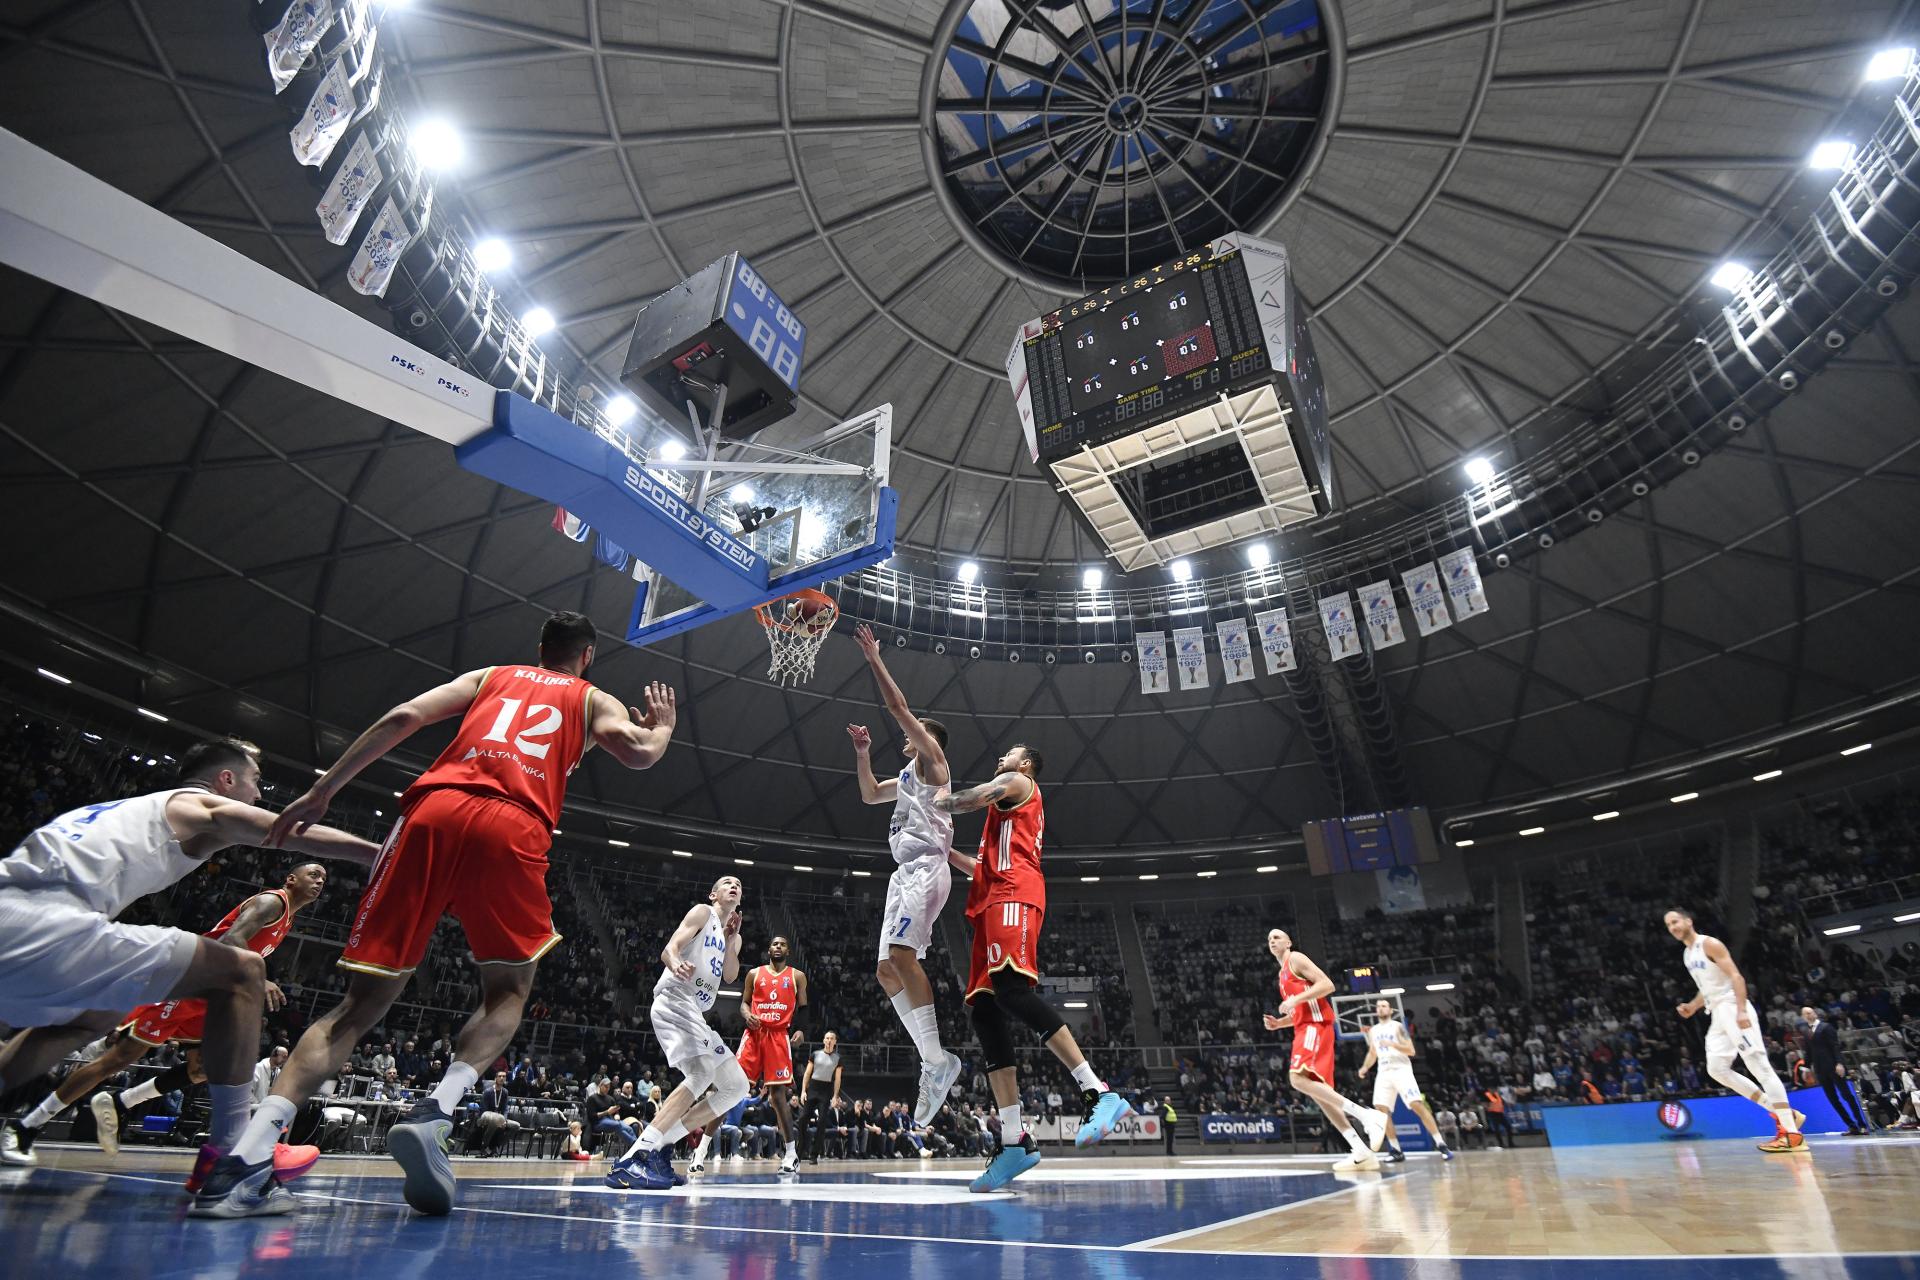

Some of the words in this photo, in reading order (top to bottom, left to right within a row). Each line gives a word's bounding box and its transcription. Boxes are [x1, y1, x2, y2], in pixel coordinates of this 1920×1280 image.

[1232, 347, 1260, 361] GUEST
[1185, 368, 1208, 380] PERIOD
[1118, 392, 1140, 405] GAME
[1141, 385, 1160, 396] TIME
[1042, 422, 1063, 434] HOME
[482, 697, 563, 760] 12
[897, 917, 911, 938] 7
[769, 989, 777, 1000] 6
[757, 1002, 788, 1011] meridian
[760, 1012, 781, 1021] mts
[783, 1066, 790, 1078] 6
[1207, 1118, 1275, 1135] cromaris
